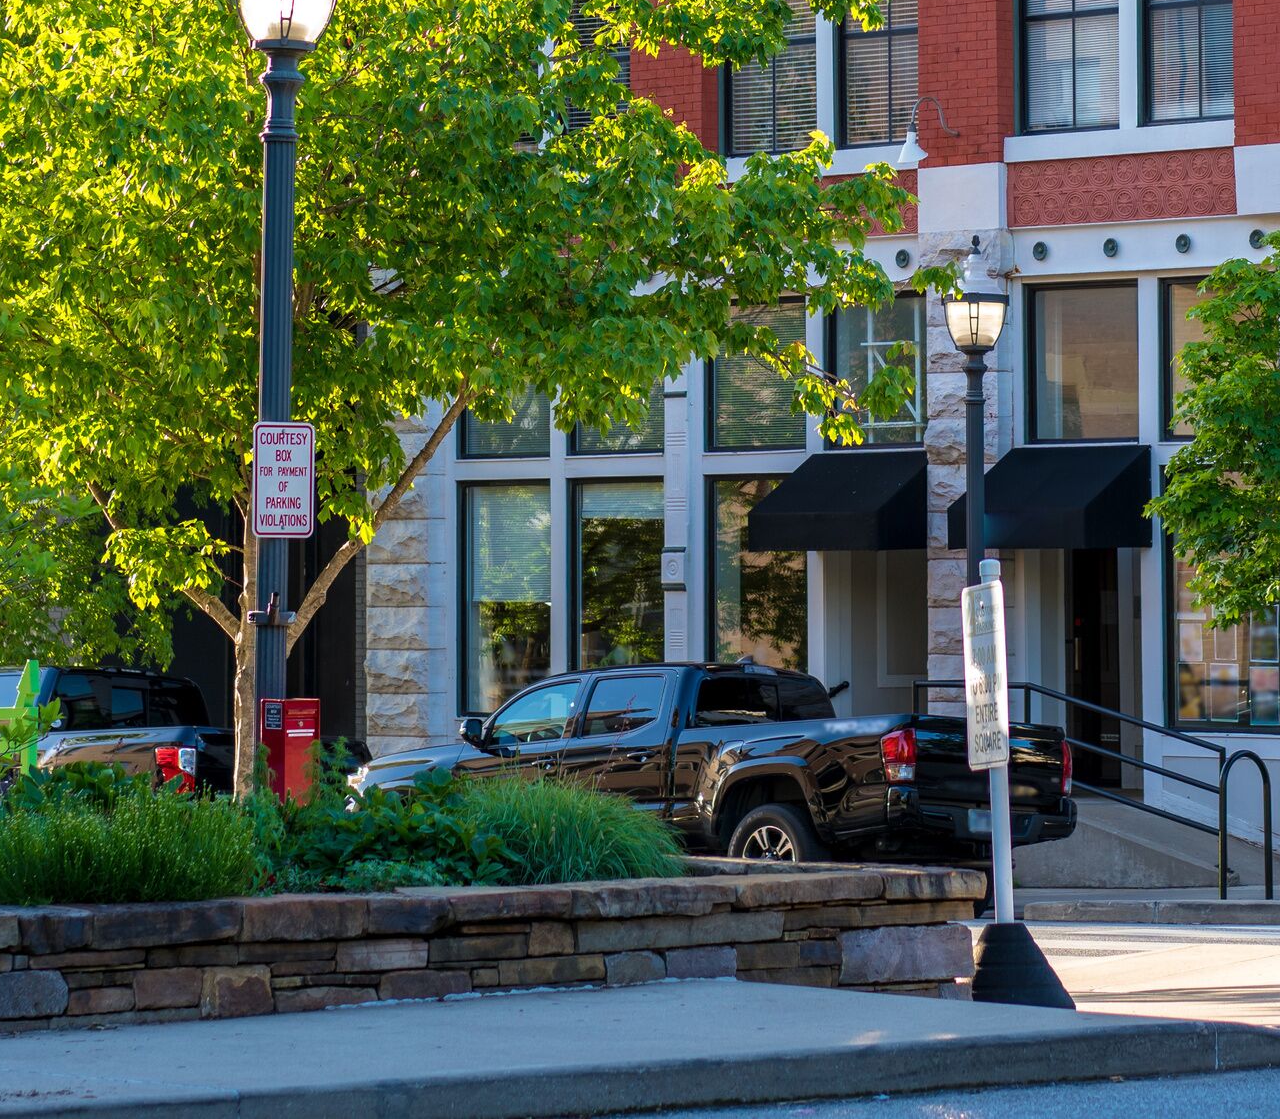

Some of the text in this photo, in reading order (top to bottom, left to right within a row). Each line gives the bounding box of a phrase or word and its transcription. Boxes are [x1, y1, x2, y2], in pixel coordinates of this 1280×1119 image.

[260, 432, 308, 445] COURTESY
[275, 450, 292, 462] BOX
[260, 466, 308, 477] FOR PAYMENT
[278, 481, 289, 493] OF
[265, 497, 301, 509] PARKING
[259, 514, 308, 527] VIOLATIONS
[975, 701, 999, 724] ENTIRE
[974, 730, 1002, 754] SQUARE
